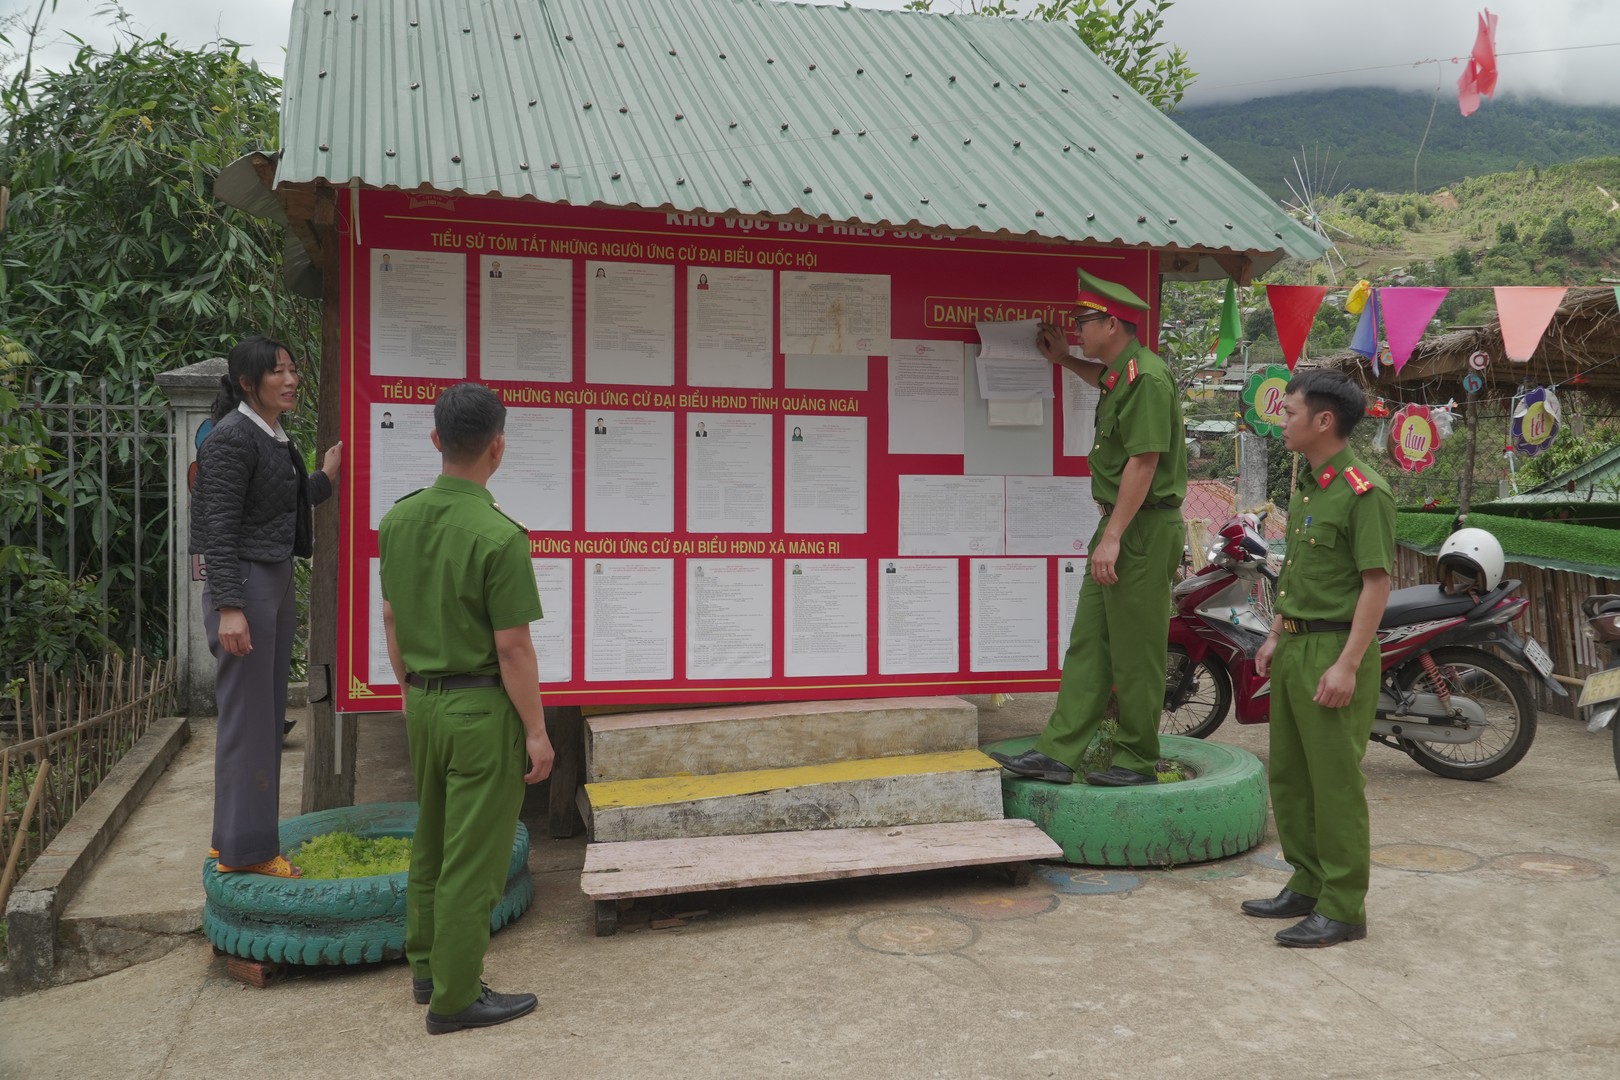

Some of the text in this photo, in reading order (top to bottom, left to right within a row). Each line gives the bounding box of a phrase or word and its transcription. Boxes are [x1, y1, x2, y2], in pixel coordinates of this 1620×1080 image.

[431, 228, 817, 270] TIỂU SỬ TÓM TẮT NHỮNG NGƯỜI ỨNG CỬ ĐẠI BIỂU QUỐC HỘI
[934, 304, 979, 323] DANH
[983, 303, 1027, 322] SÁCH
[382, 380, 413, 400] TIỂU
[417, 383, 436, 400] SỬ
[503, 387, 551, 403] NHỮNG
[554, 389, 597, 405] NGƯỜI
[600, 390, 629, 407] ỨNG
[632, 390, 651, 407] CỬ
[654, 393, 676, 409] ĐẠI
[679, 390, 709, 408] BIỂU
[712, 395, 748, 409] HĐND
[750, 394, 779, 410] TỈNH
[782, 395, 826, 411] QUẢNG
[829, 397, 859, 412] NGÃI
[574, 538, 617, 554] NGƯỜI
[620, 538, 648, 554] ỨNG
[651, 537, 671, 554] CỬ
[672, 540, 695, 556] ĐẠI
[698, 535, 727, 554] BIỂU
[730, 540, 766, 554] HĐND
[768, 538, 786, 554] XÃ
[788, 538, 825, 555] MĂNG
[828, 541, 840, 554] RI
